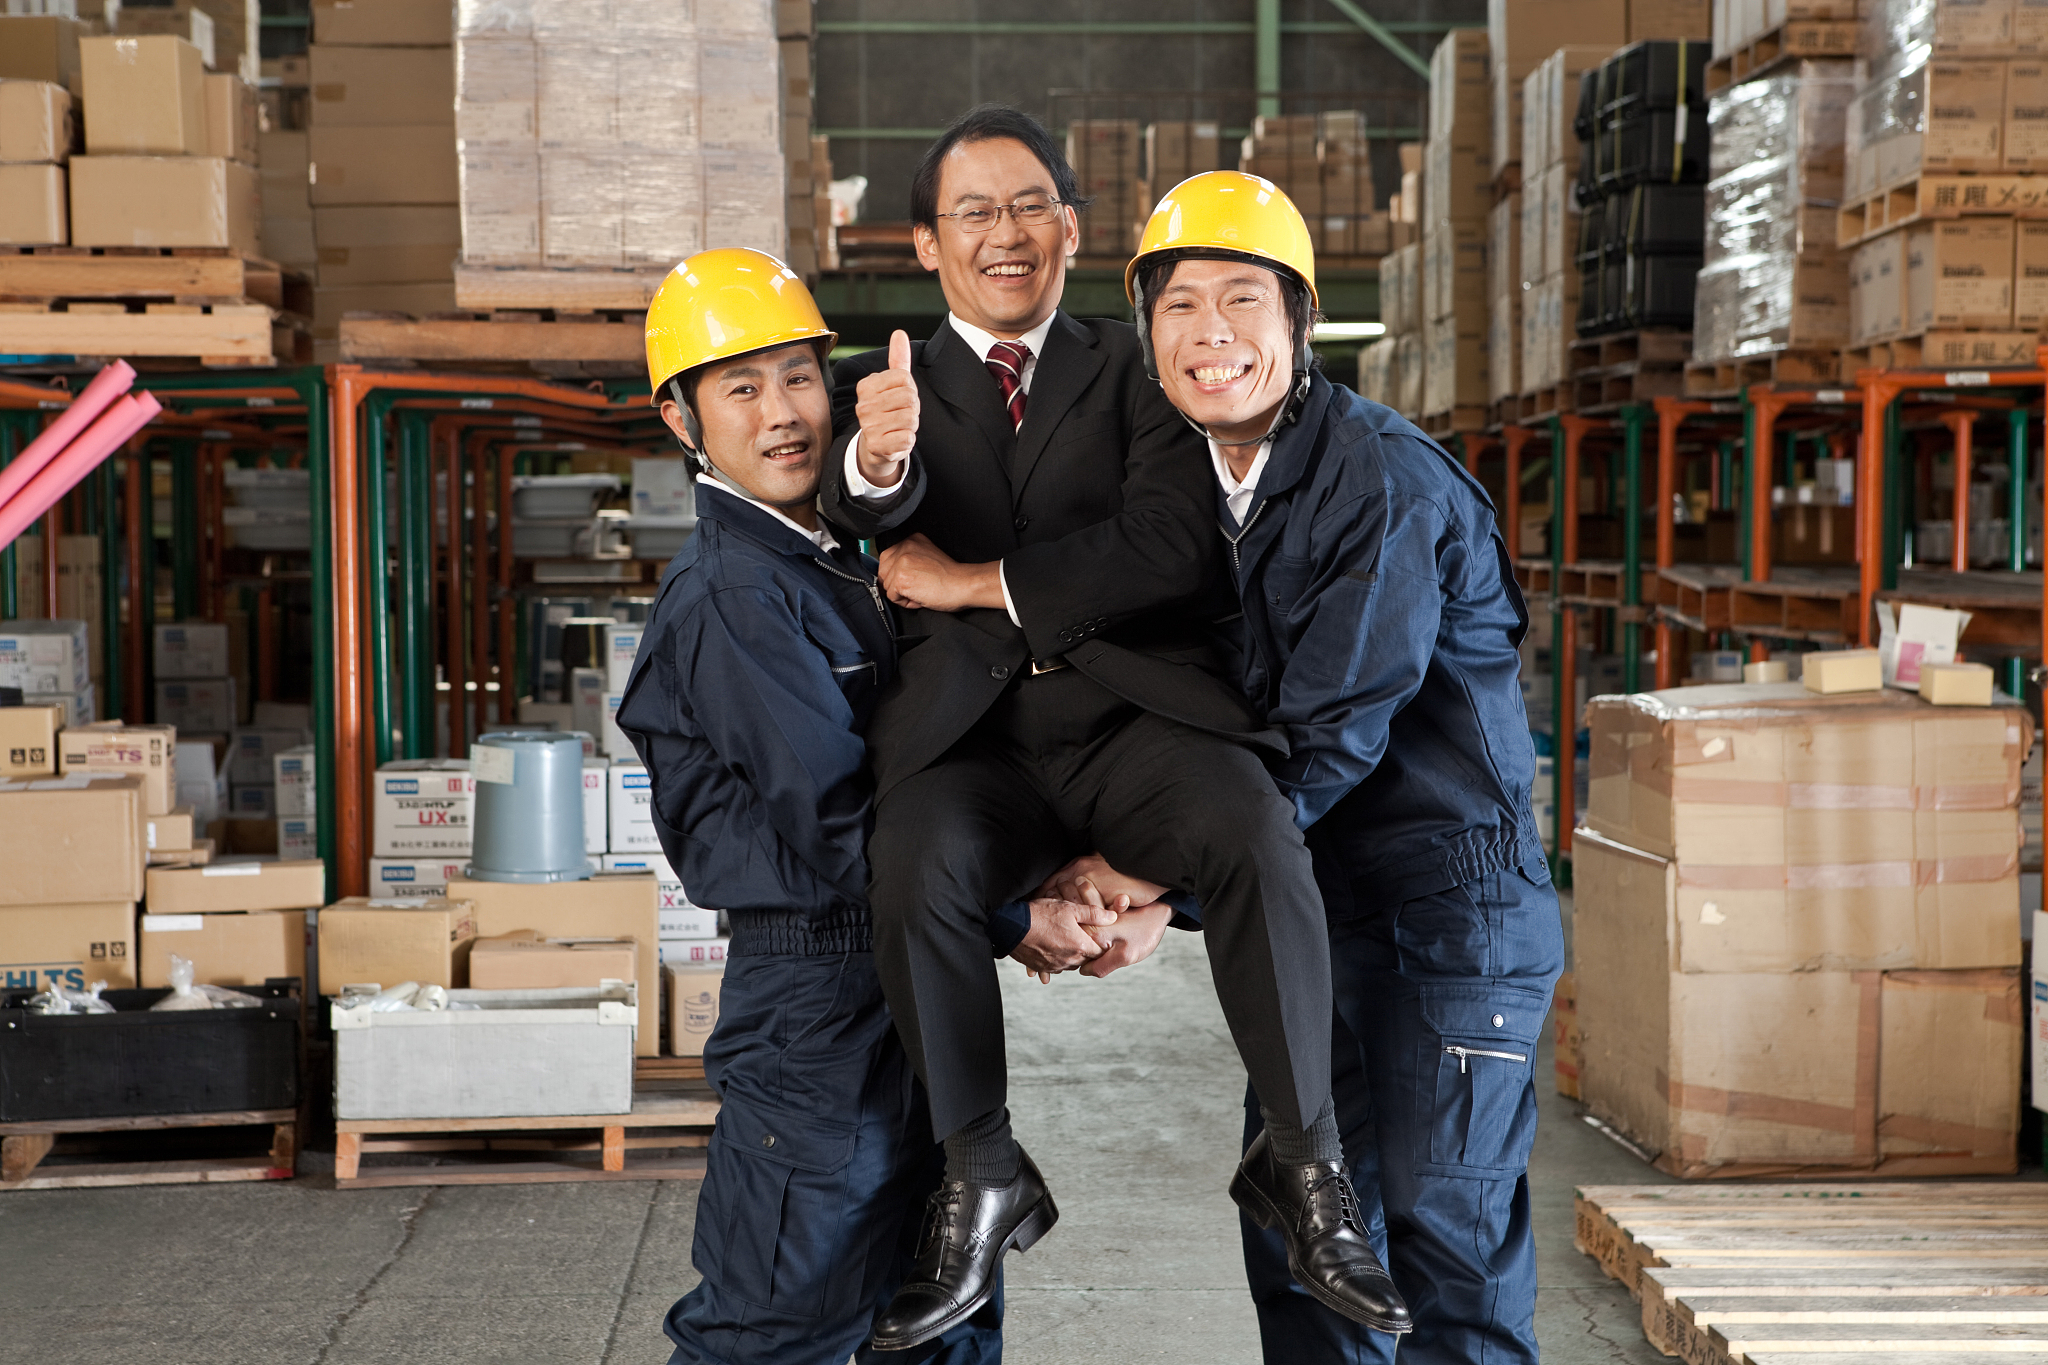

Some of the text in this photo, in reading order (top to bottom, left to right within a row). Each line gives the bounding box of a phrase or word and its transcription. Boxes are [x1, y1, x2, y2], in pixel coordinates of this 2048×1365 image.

[117, 749, 142, 763] TS
[387, 781, 417, 792] SEKISUI
[419, 811, 447, 824] UX
[384, 869, 413, 880] SEKISUI
